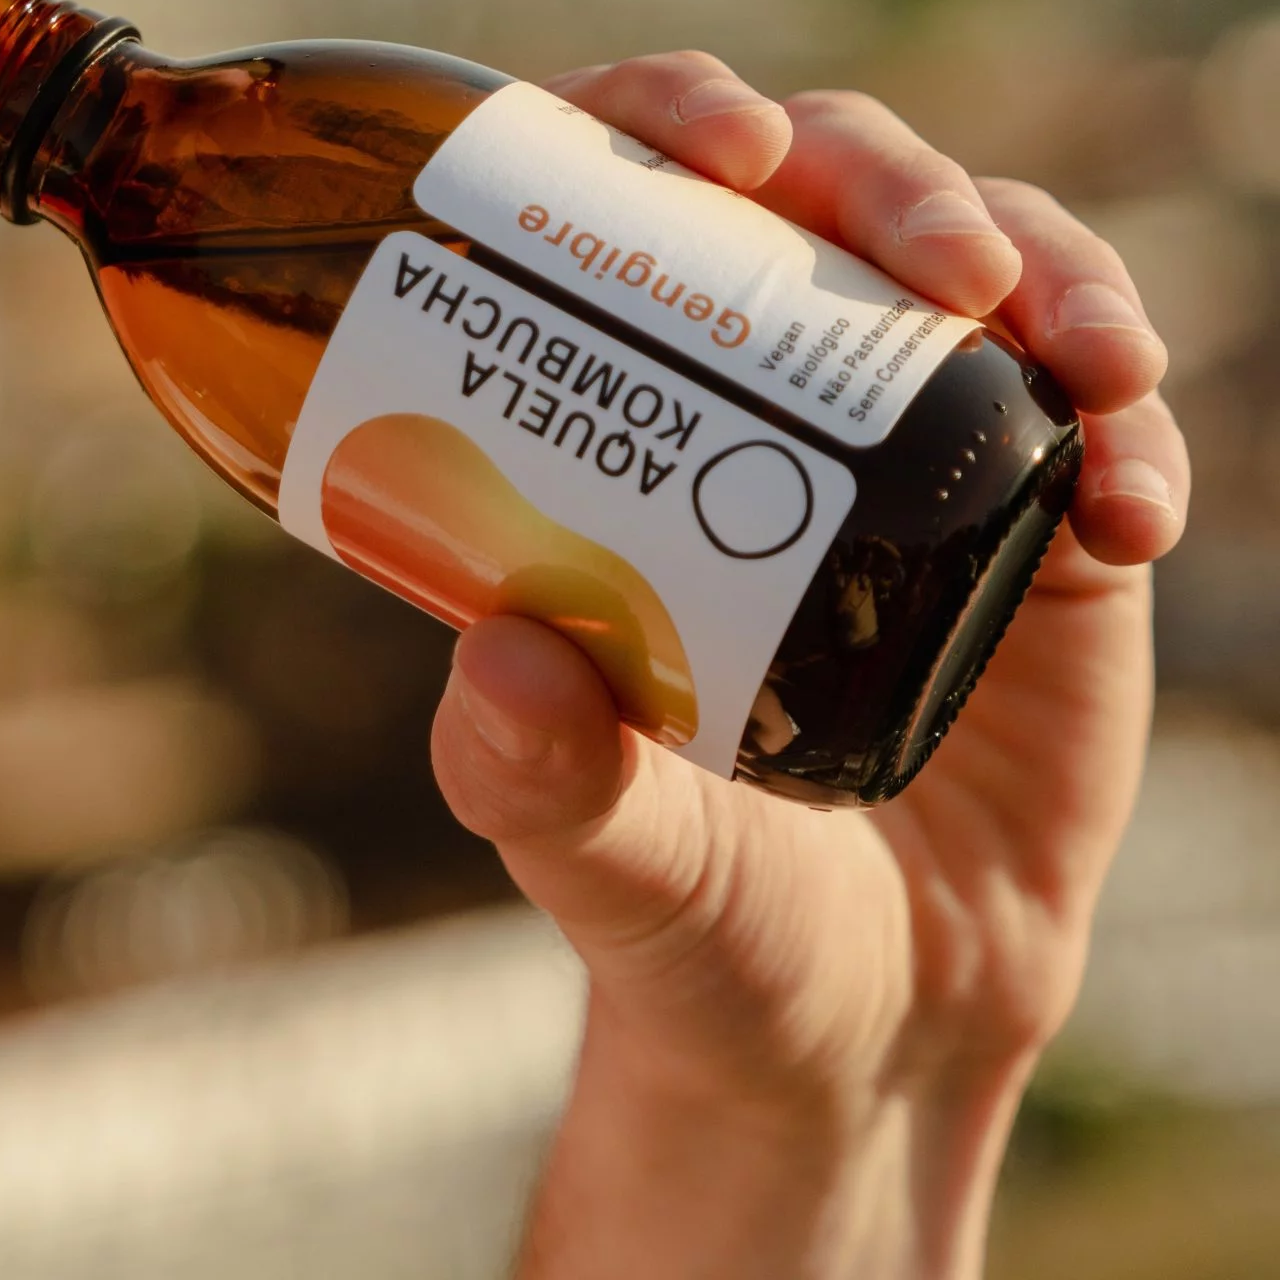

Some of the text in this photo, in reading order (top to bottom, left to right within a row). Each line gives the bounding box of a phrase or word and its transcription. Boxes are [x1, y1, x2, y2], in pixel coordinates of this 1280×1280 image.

[518, 204, 751, 349] Gengibre
[393, 251, 702, 452] KOMBUCHA
[759, 321, 806, 372] Vegan
[789, 318, 851, 390] Biológico
[818, 297, 915, 406] Não Pasteurizado
[848, 311, 947, 422] Sem Conservantes
[461, 350, 678, 496] AQUELA
